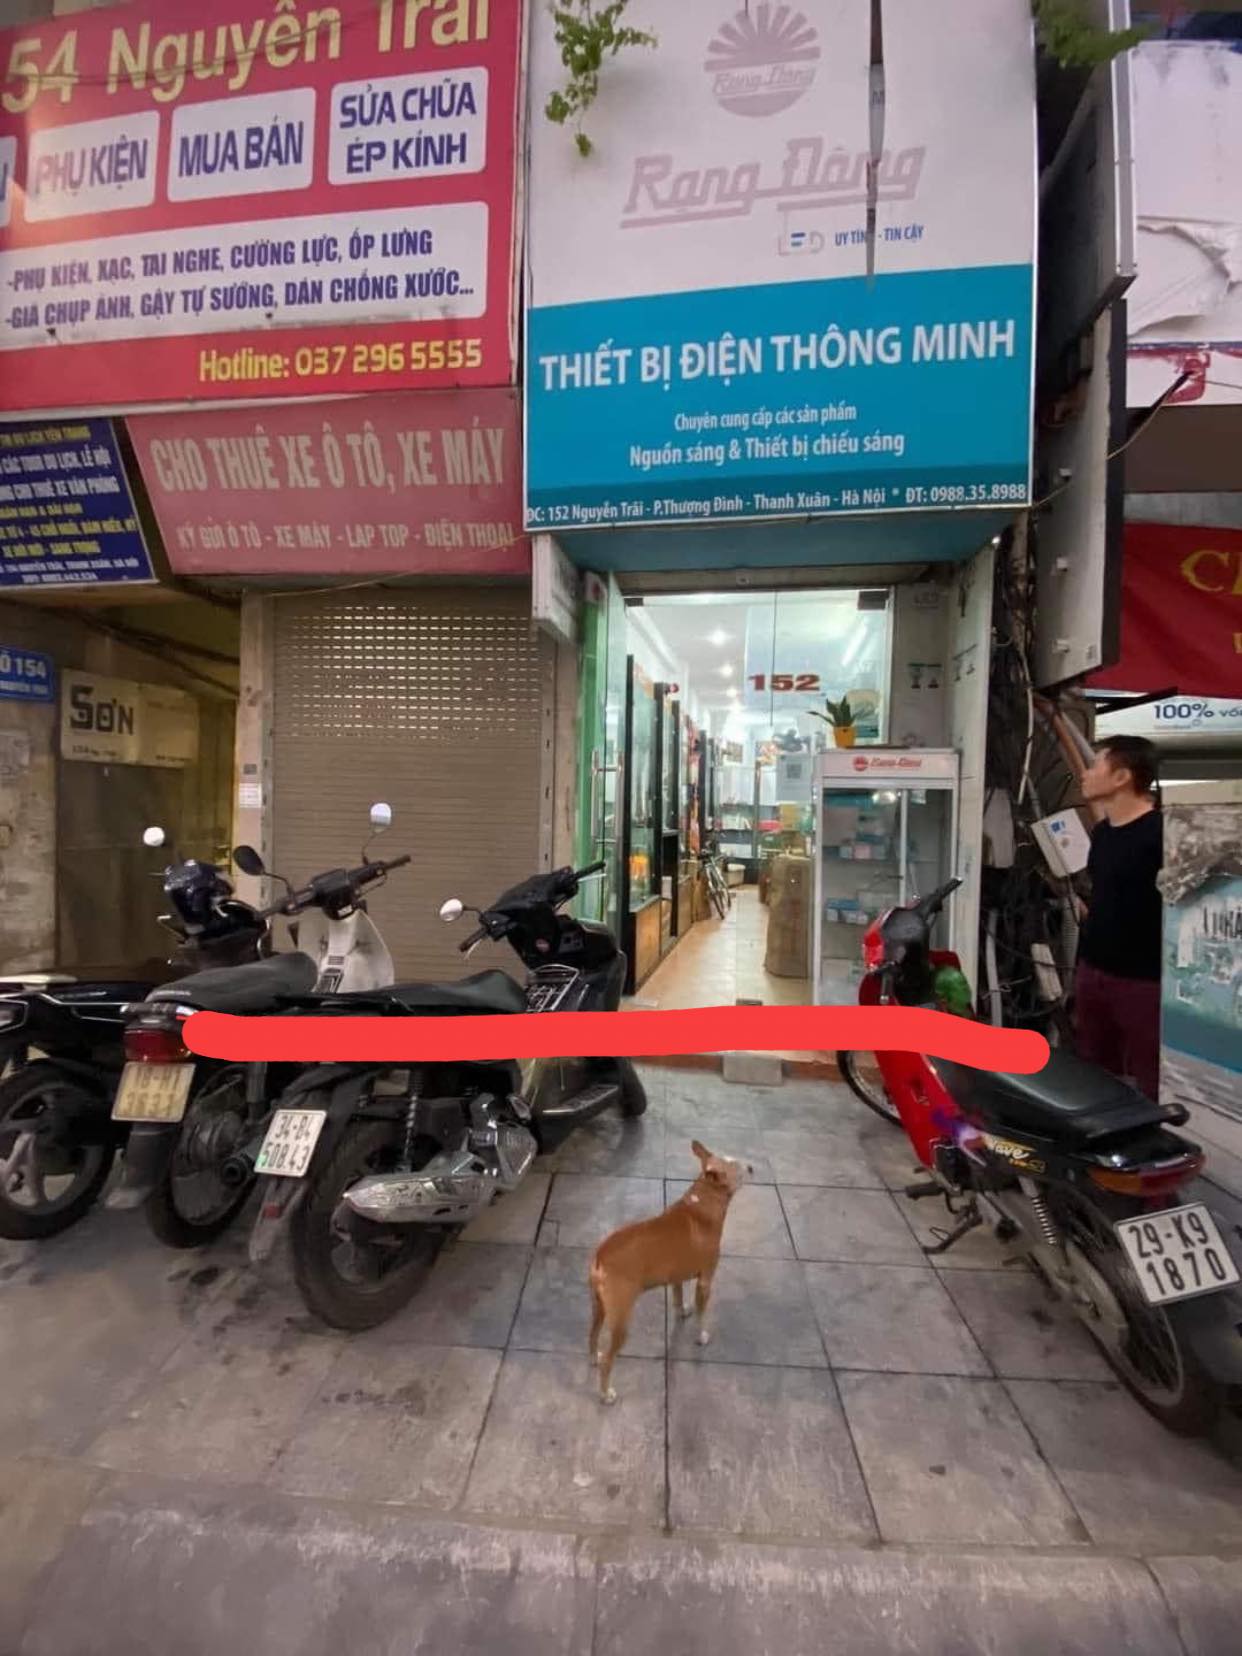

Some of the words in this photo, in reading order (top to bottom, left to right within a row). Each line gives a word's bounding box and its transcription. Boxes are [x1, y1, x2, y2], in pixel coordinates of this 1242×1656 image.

[339, 83, 396, 129] SỬA
[401, 78, 477, 122] CHỮA
[34, 148, 86, 198] PHỤ
[89, 134, 149, 191] KIỆN
[178, 130, 239, 177] MUA
[244, 115, 304, 170] BÁN
[346, 136, 387, 174] ÉP
[392, 129, 467, 170] KÍNH
[141, 253, 167, 277] TAI
[172, 248, 225, 274] NGHE,
[230, 238, 296, 269] CƯỜNG
[301, 234, 342, 266] LỰC,
[381, 227, 432, 257] LƯNG
[329, 268, 398, 303] CHỐNG
[199, 347, 290, 382] Hotline:
[295, 346, 347, 376] 037
[352, 343, 404, 373] 296
[410, 338, 483, 371] 5555
[538, 338, 633, 391] THIẾT
[640, 346, 672, 391] BỊ
[679, 331, 763, 386] ĐIỆN
[770, 323, 901, 373] THÔNG
[911, 319, 1016, 363] MINH
[674, 411, 717, 433] Chuyên
[720, 412, 750, 430] cung
[751, 405, 773, 428] cấp
[775, 405, 796, 424] các
[796, 404, 819, 423] sản
[821, 400, 857, 426] phẩm
[150, 437, 208, 491] CHO
[204, 423, 281, 489] THUÊ
[278, 435, 321, 488] XE
[321, 421, 345, 489] Ô
[346, 419, 396, 495] TÔ,
[396, 430, 438, 486] XE
[440, 415, 505, 486] MÁY
[630, 438, 682, 471] Nguồn
[685, 441, 725, 467] sáng
[729, 438, 741, 461] &
[744, 432, 790, 459] Thiết
[792, 434, 809, 461] bị
[812, 429, 859, 456] chiếu
[863, 430, 906, 456] sáng
[549, 505, 569, 521] 152
[572, 501, 618, 523] Nguyễn
[621, 501, 644, 517] Trãi
[653, 499, 711, 518] P.Thượng
[713, 494, 743, 511] Đình
[753, 493, 794, 510] Thanh
[797, 490, 831, 507] Xuân
[841, 488, 860, 505] Hà
[863, 487, 886, 507] Nội
[905, 487, 927, 503] ĐT:
[930, 484, 1027, 502] 0988.35.8988
[273, 525, 297, 548] XE
[296, 519, 332, 549] MÁY
[345, 524, 375, 548] LAP
[377, 524, 409, 548] TOP
[424, 518, 464, 552] ĐIỆN
[466, 522, 514, 552] THOẠI
[15, 657, 47, 680] 154
[748, 673, 820, 692] 152
[69, 684, 134, 736] SƠN
[1154, 703, 1215, 720] 100%
[1127, 1211, 1209, 1259] 29-K9
[1146, 1247, 1227, 1296] 1870
